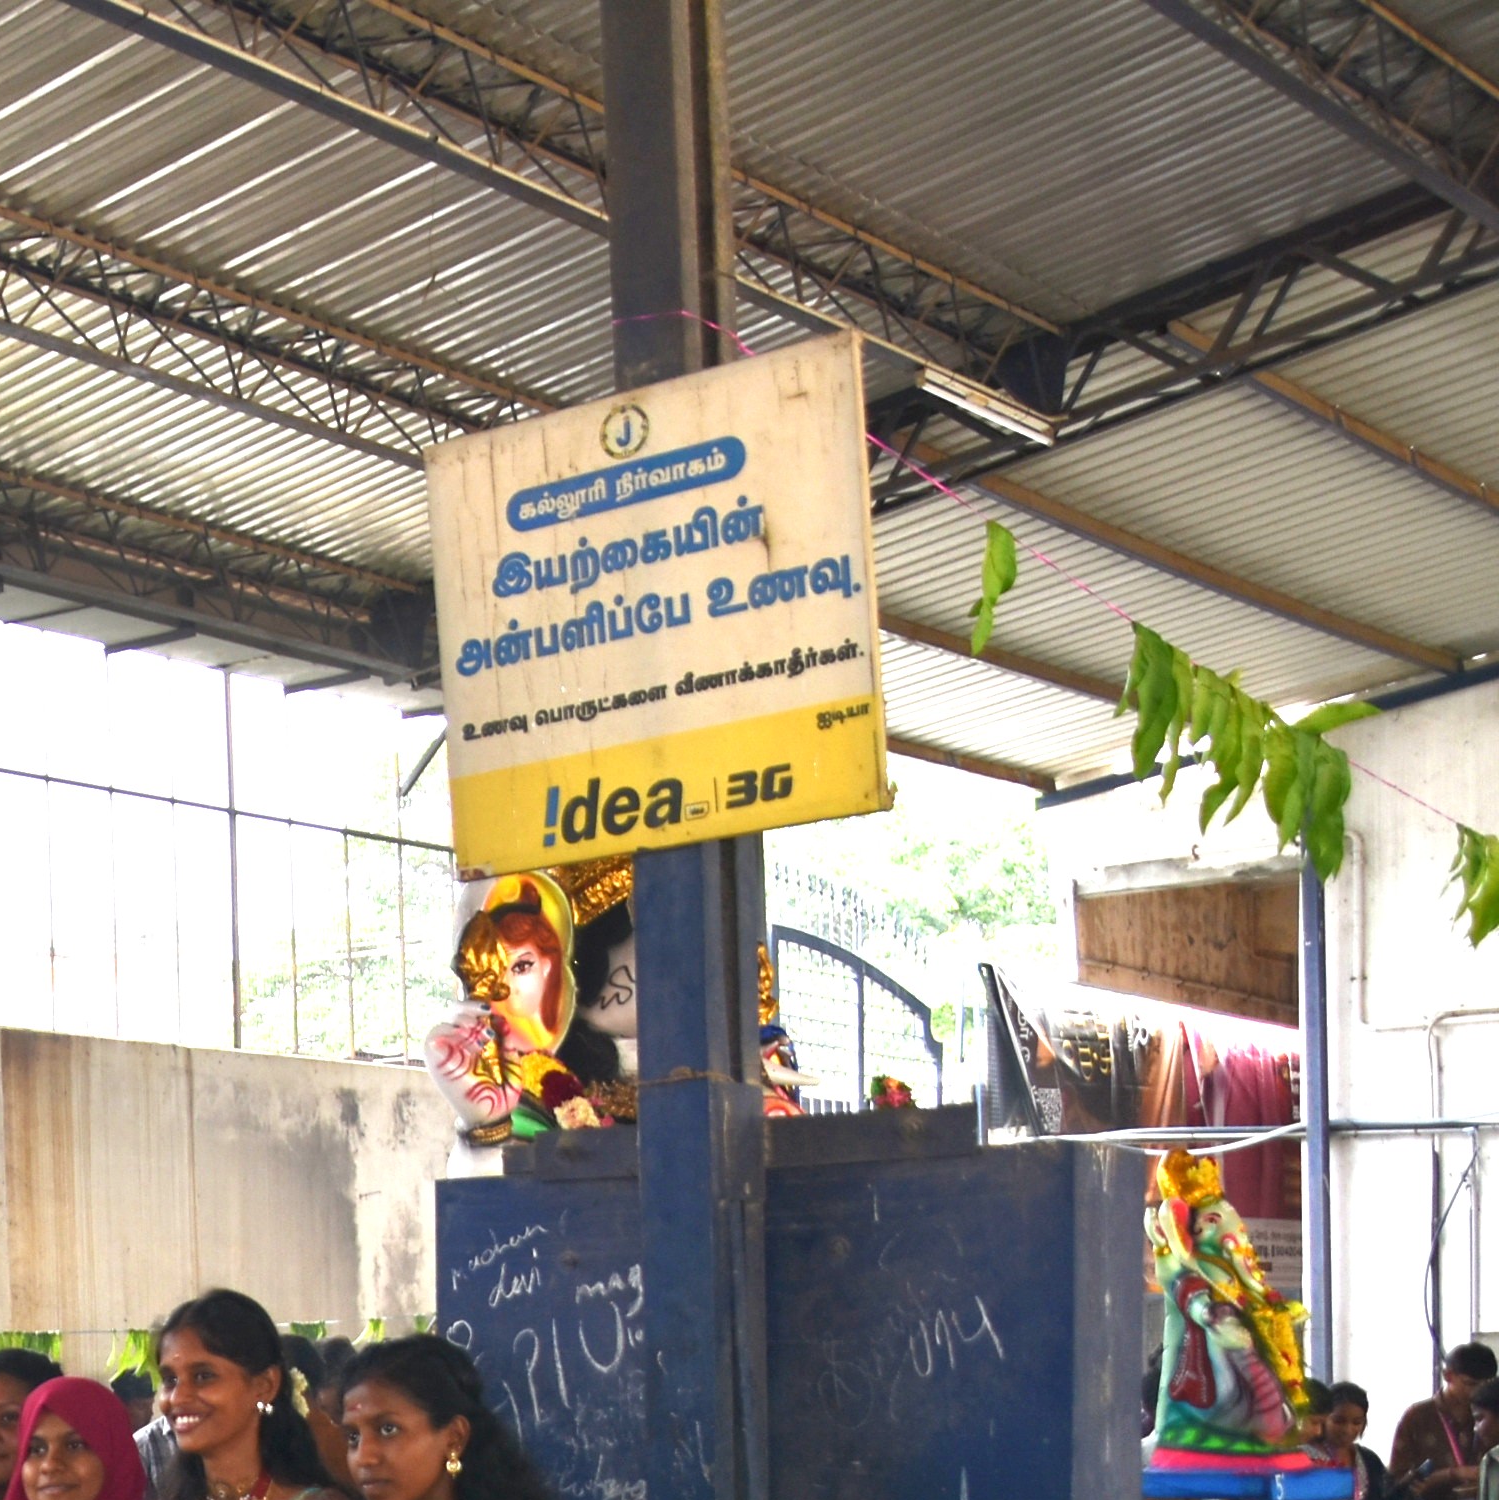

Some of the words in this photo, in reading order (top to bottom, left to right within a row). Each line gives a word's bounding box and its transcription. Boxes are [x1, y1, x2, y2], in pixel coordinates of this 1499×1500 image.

[518, 478, 607, 520] கல்லூரி
[615, 447, 727, 501] நிர்வாகம்
[491, 495, 766, 598] இயற்கையின்
[456, 590, 691, 677] அன்பளிப்பே
[707, 554, 862, 619] உணவு.
[462, 714, 528, 741] உணவு
[535, 684, 668, 727] பொருட்களை
[674, 637, 865, 697] வீணாக்காதீர்கள்.
[816, 701, 870, 730] ஐடியா
[725, 763, 794, 809] 3G
